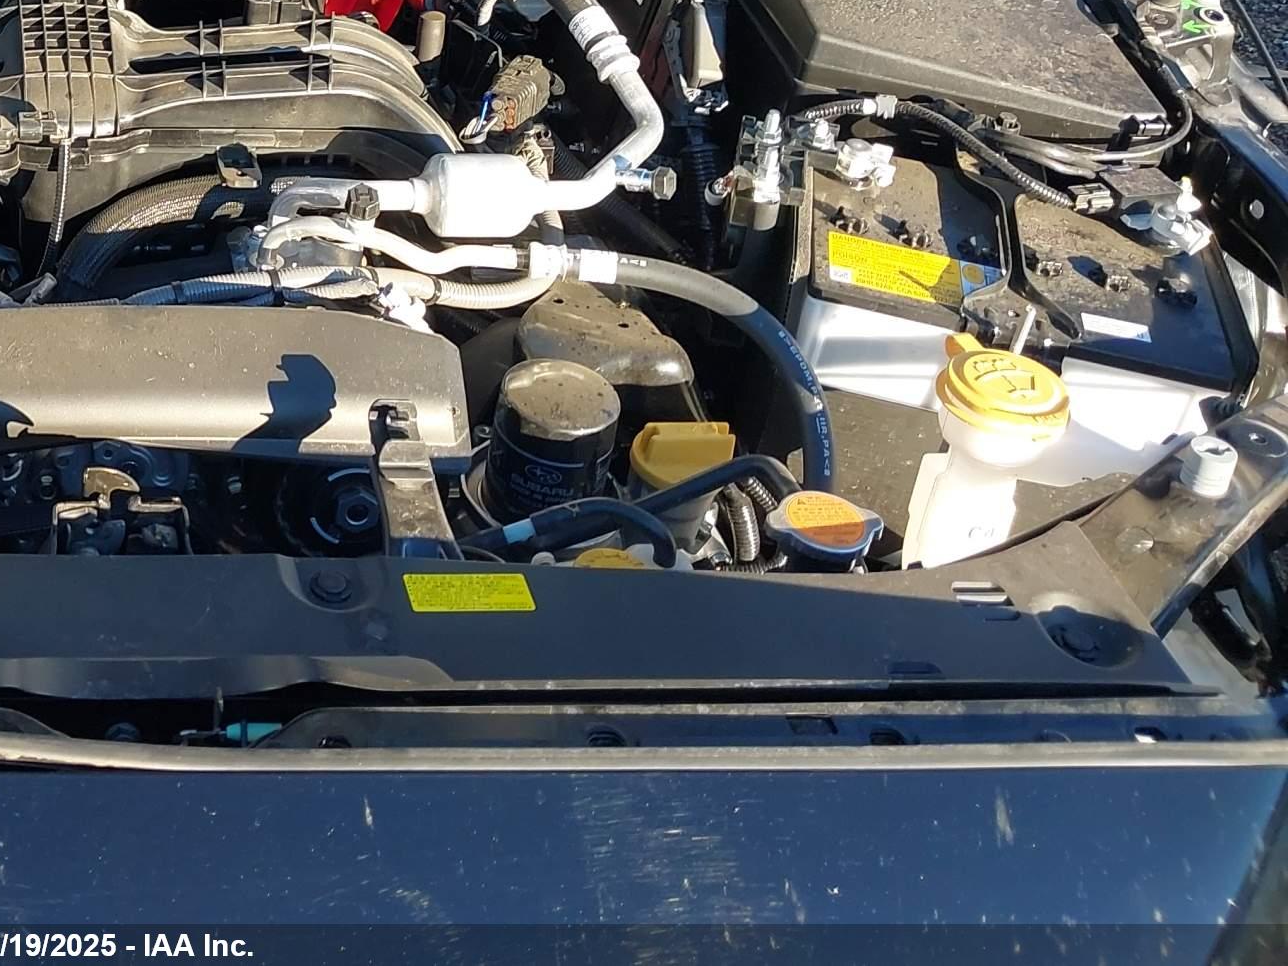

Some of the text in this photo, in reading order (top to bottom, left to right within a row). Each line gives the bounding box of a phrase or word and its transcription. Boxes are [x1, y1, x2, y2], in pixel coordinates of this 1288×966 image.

[832, 233, 869, 246] DANGER
[832, 250, 868, 263] POISON
[510, 473, 575, 497] SUBARU
